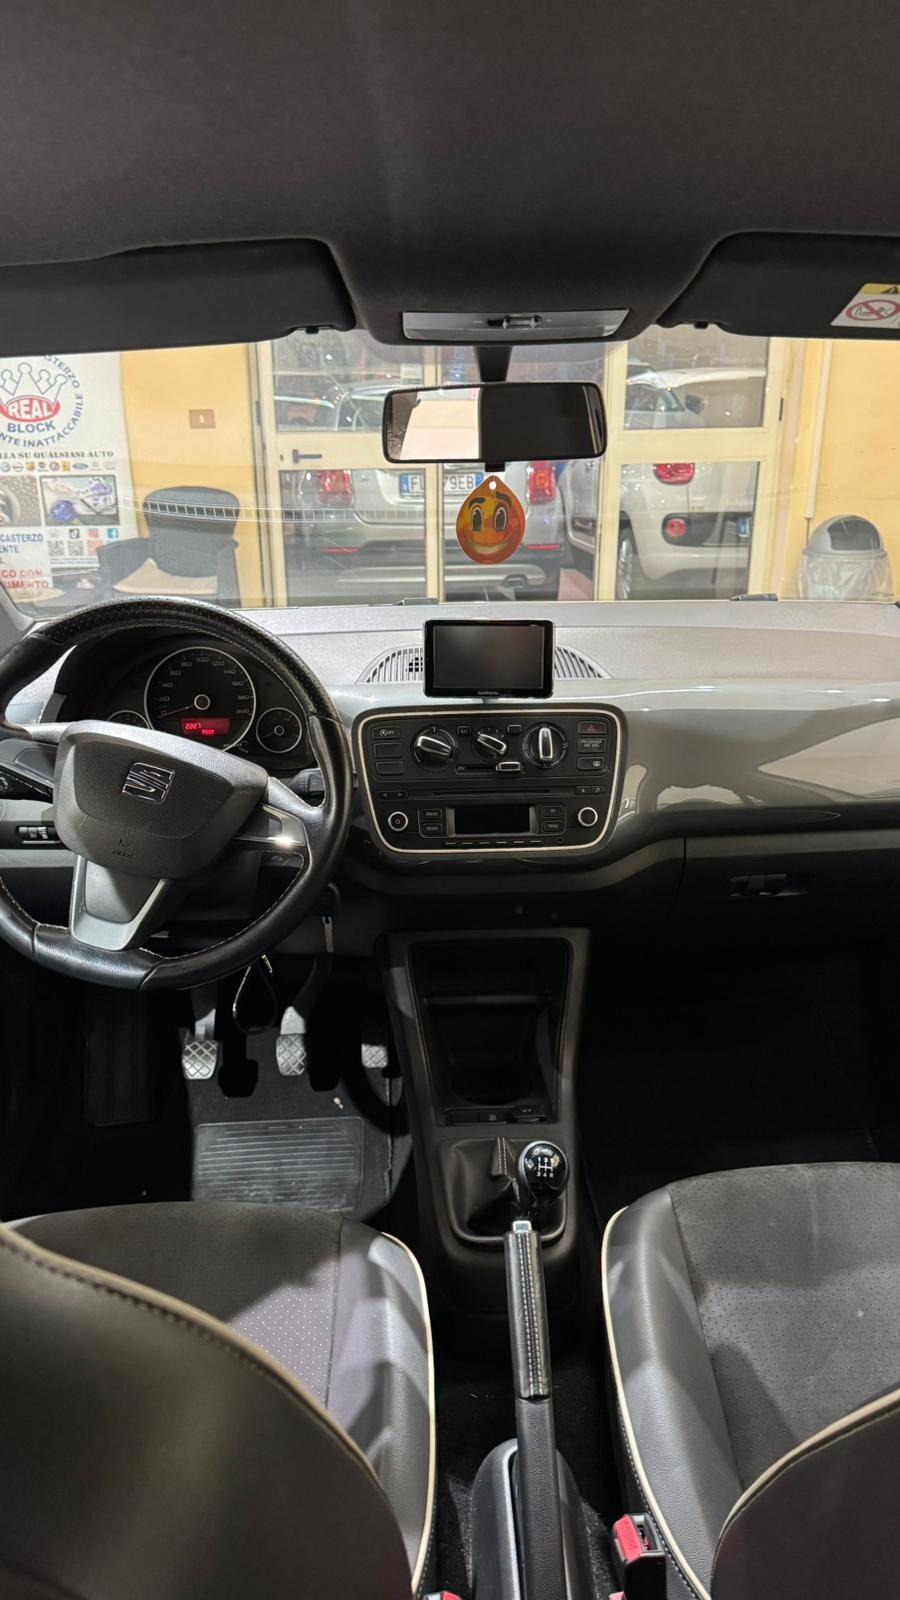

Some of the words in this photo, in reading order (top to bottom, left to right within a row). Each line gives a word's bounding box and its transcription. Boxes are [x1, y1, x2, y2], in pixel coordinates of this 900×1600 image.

[7, 398, 54, 420] REAL
[7, 420, 56, 433] BLOCK
[23, 393, 84, 447] INATTACCABILE
[87, 450, 114, 458] AUTO
